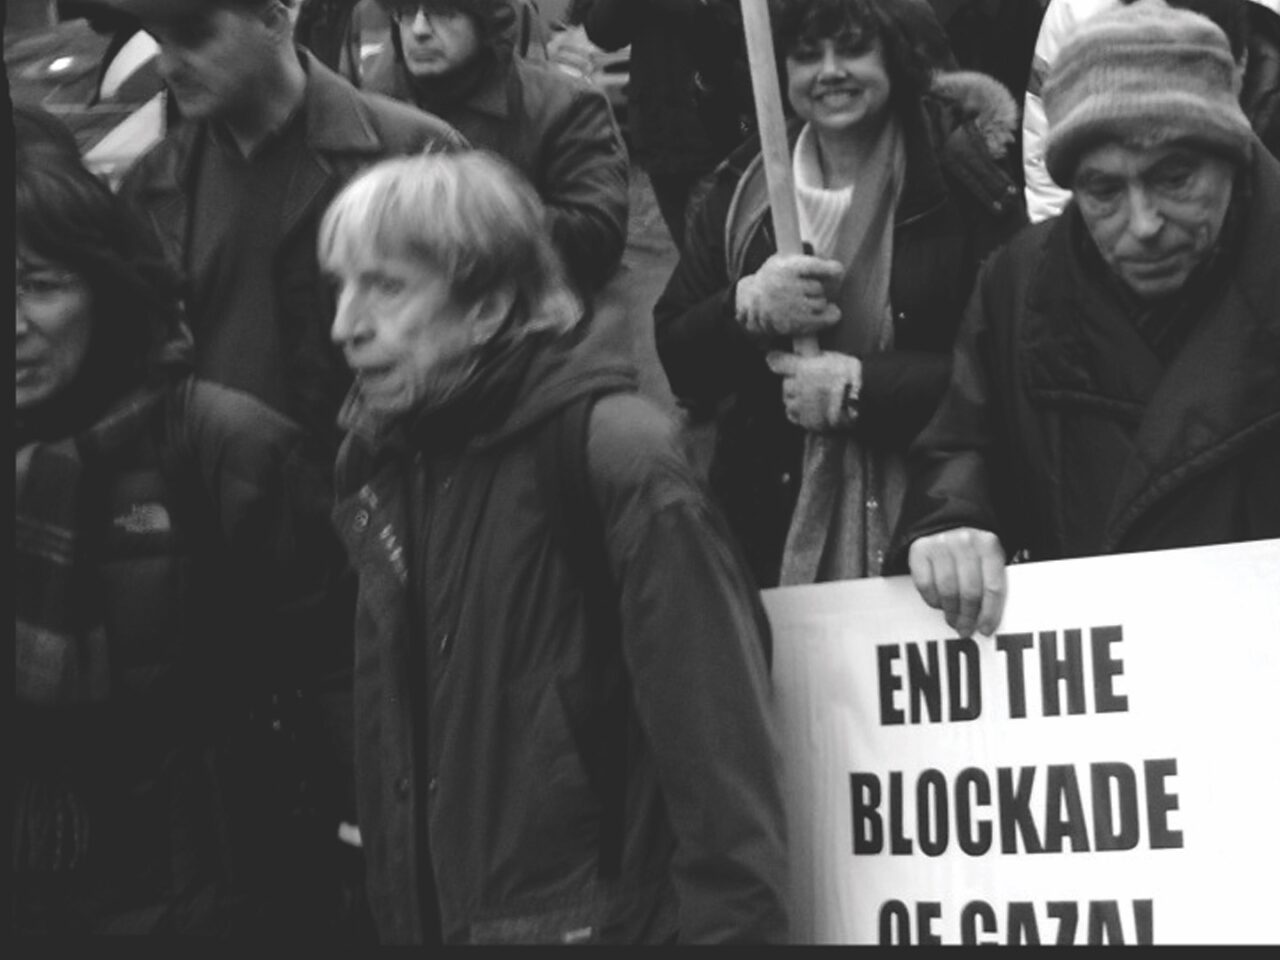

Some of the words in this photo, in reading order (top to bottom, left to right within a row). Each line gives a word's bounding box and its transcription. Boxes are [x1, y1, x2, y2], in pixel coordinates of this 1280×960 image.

[876, 637, 982, 726] END
[995, 625, 1129, 719] THE
[849, 758, 1184, 858] BLOCKADE
